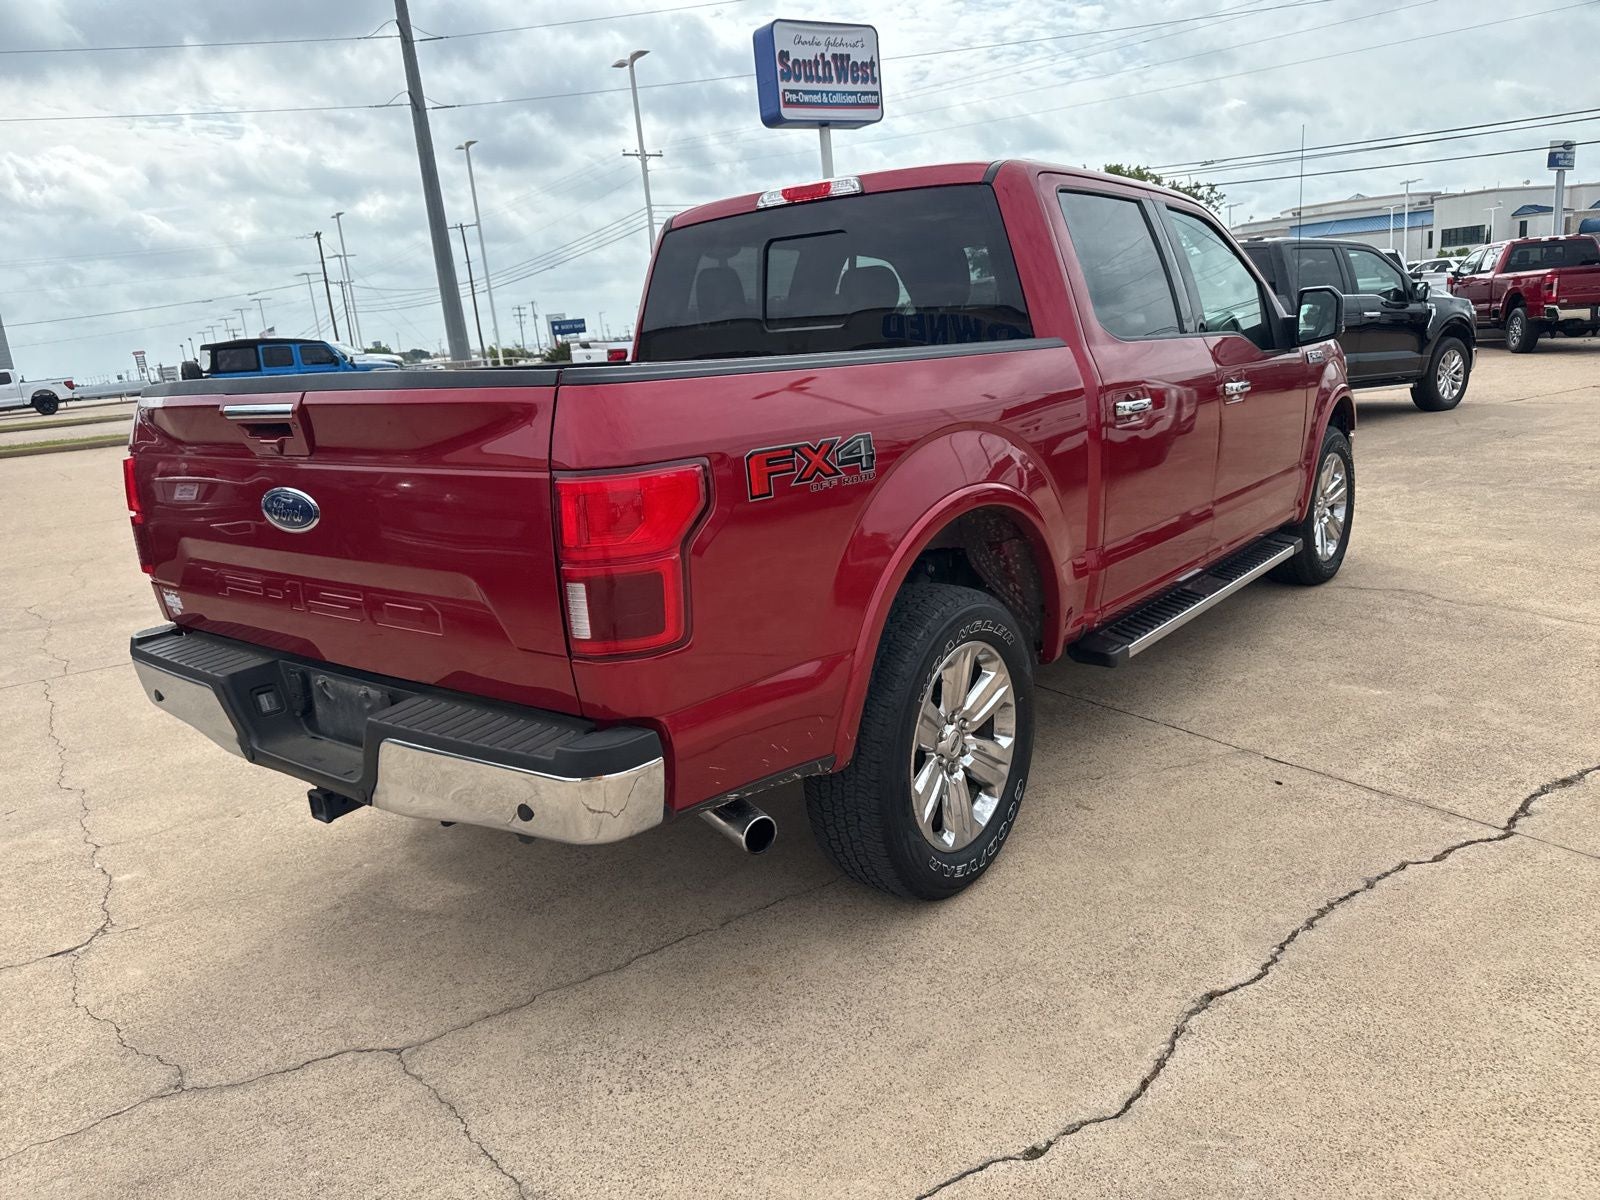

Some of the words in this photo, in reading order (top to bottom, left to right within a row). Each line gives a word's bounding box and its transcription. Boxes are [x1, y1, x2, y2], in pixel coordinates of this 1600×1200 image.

[793, 34, 822, 46] Charlie
[824, 37, 865, 52] Gilchrist's
[777, 49, 878, 85] SouthWest
[785, 91, 821, 103] Pre-Owned
[822, 93, 828, 103] &
[828, 94, 857, 105] Collision
[857, 94, 879, 104] Center
[744, 432, 876, 502] FX4
[810, 479, 837, 492] OFF
[842, 472, 876, 486] ROAD
[272, 496, 303, 522] Ford
[214, 568, 445, 637] F-150
[929, 778, 1024, 878] GOODYEAR
